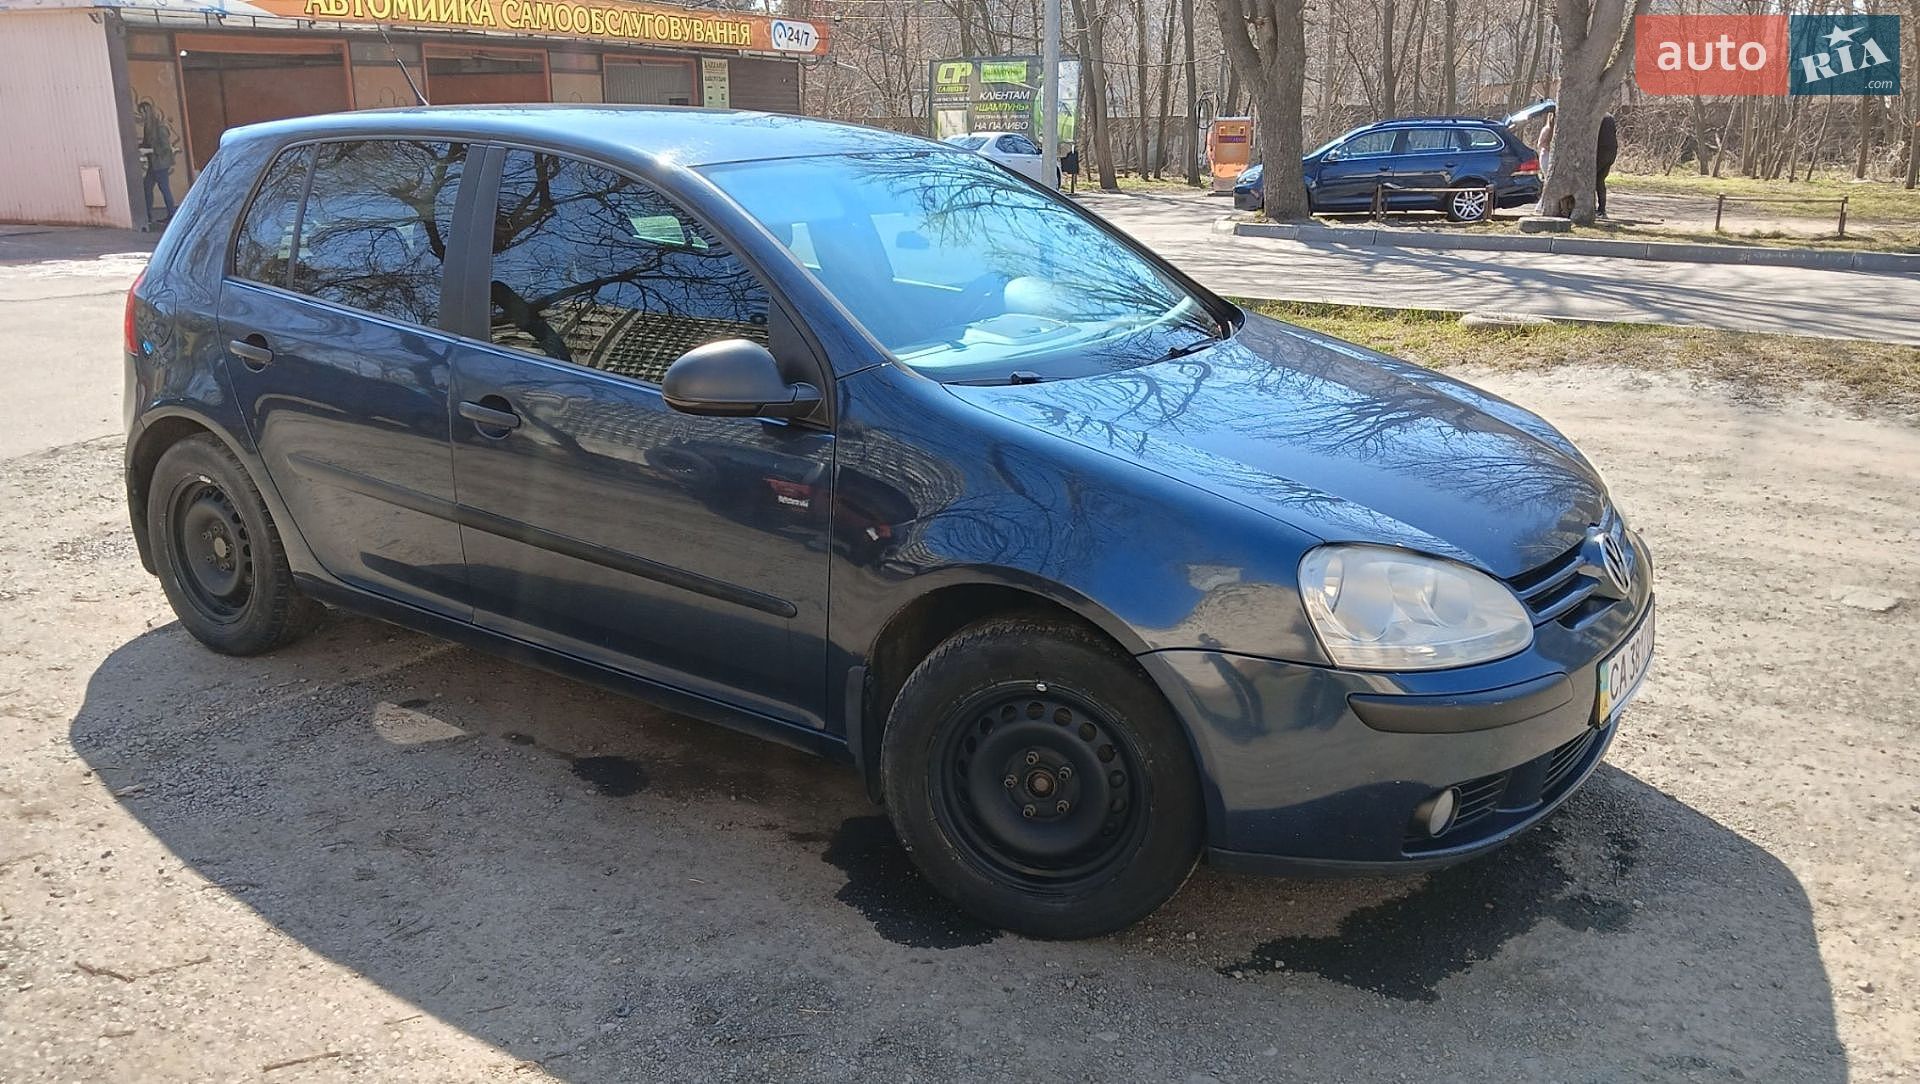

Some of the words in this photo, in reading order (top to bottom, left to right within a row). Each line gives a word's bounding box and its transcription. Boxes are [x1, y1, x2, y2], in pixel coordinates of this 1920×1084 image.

[501, 0, 752, 46] САМООБСЛУГОВУВАННЯ
[787, 26, 810, 47] 24/7
[988, 120, 1029, 130] ПАЛИВО
